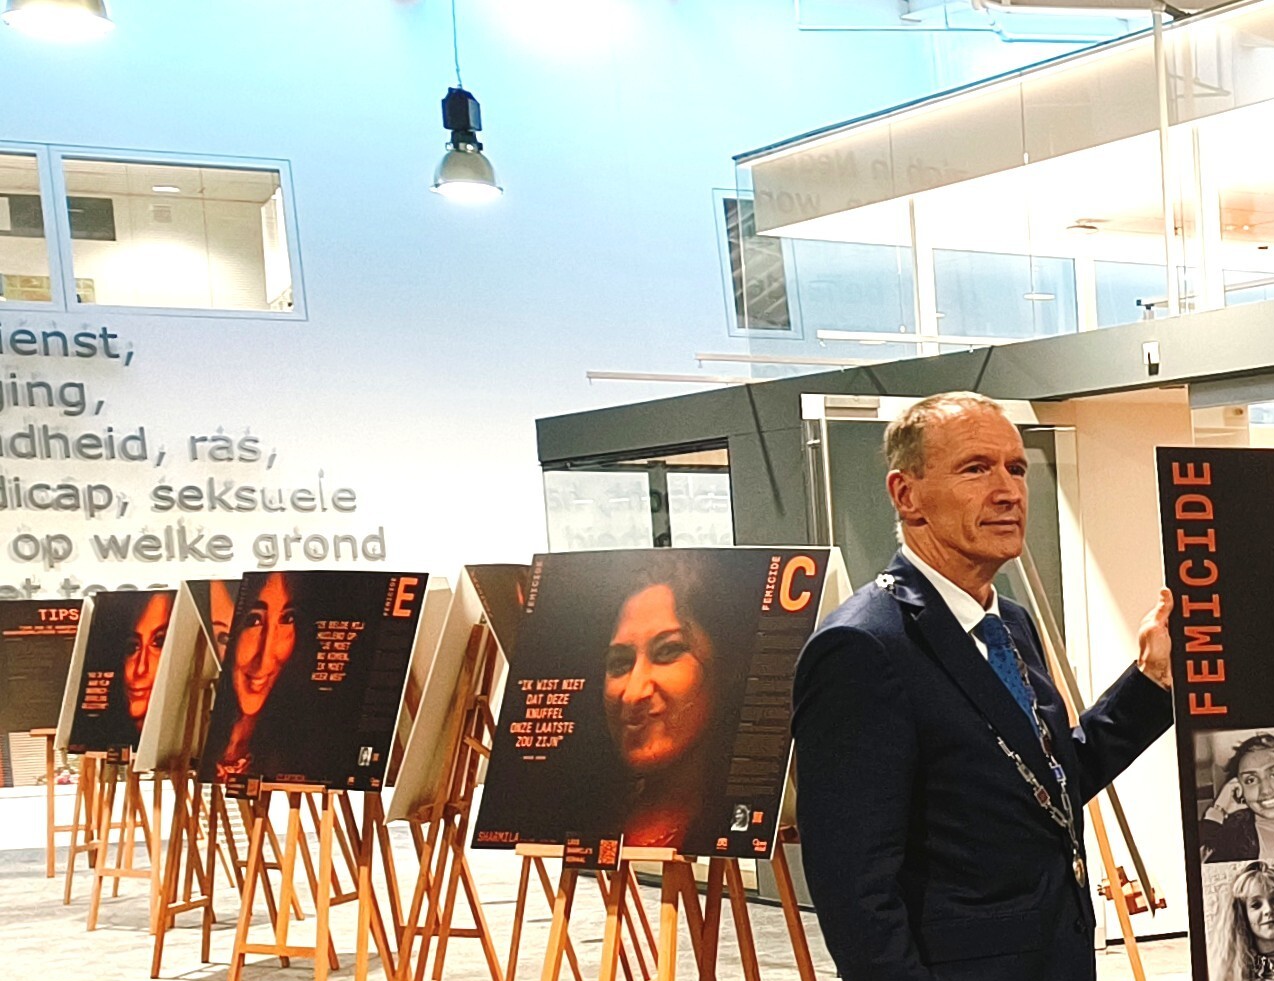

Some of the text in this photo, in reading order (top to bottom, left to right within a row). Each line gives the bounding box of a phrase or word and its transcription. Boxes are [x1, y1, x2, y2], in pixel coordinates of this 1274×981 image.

[0, 372, 104, 416] ing,
[0, 424, 277, 470] dheid, ras,
[151, 472, 357, 512] seksuele
[11, 525, 387, 569] op welke grond
[392, 577, 419, 617] E
[761, 555, 816, 611] FEMICIDE C
[1171, 462, 1228, 715] FEMICIDE
[38, 608, 80, 621] TIPS
[526, 693, 570, 705] DAT DEZE
[536, 679, 560, 691] WIST
[562, 678, 586, 690] NIET
[510, 721, 575, 733] ONZE LAATSTE
[525, 707, 563, 719] KNUFFEL
[515, 736, 534, 747] ZOU
